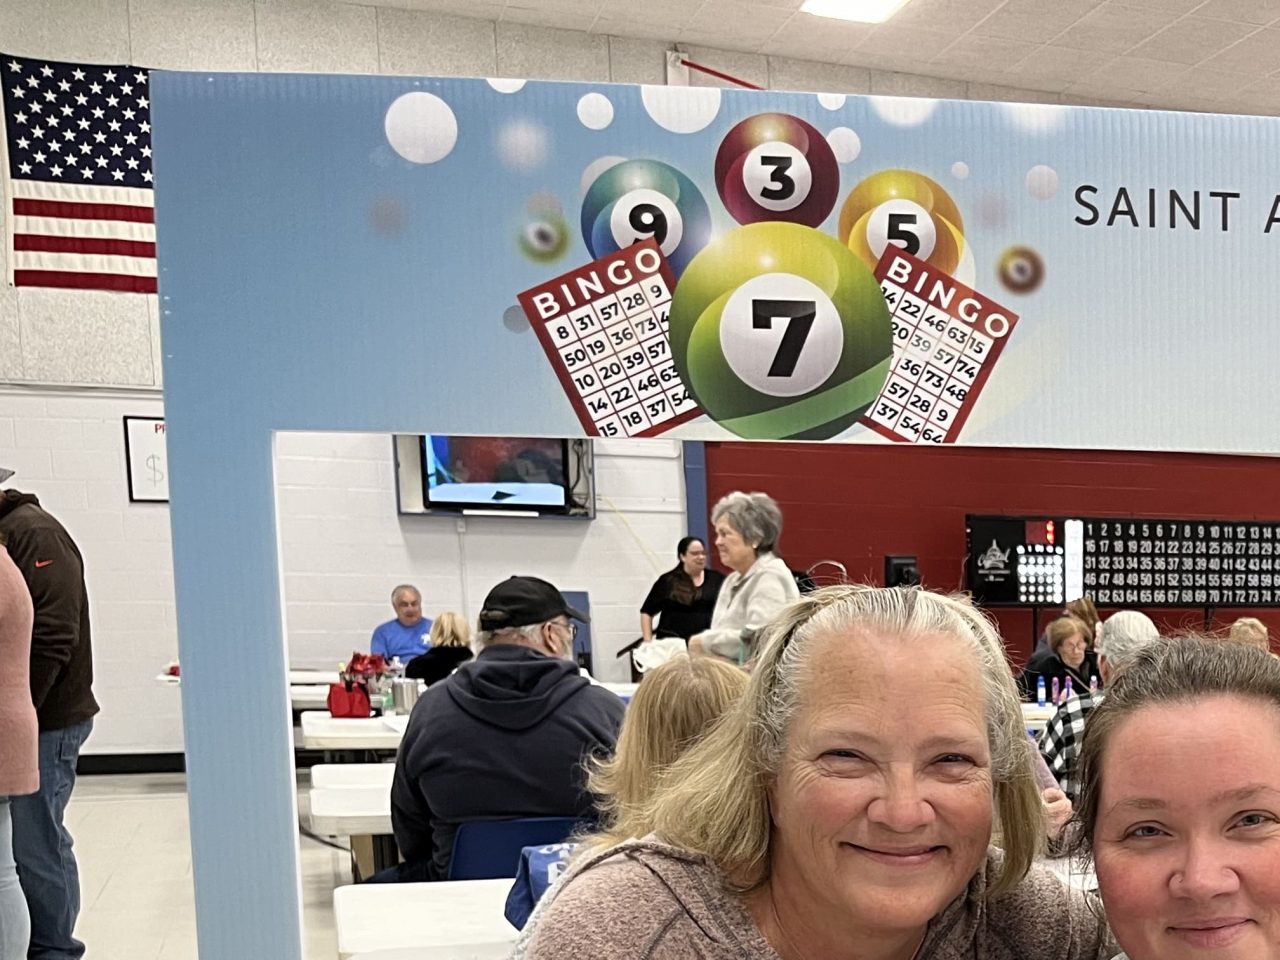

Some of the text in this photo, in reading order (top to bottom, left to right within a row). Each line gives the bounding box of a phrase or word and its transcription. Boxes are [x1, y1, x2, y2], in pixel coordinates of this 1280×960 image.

[759, 156, 795, 201] 3
[629, 203, 667, 245] 9
[1074, 184, 1240, 231] SAINT
[886, 214, 920, 257] 5
[533, 248, 661, 320] BINGO
[887, 256, 1009, 338] BINGO
[557, 285, 662, 339] 8 31 57 28 9
[901, 300, 921, 318] 22
[925, 315, 945, 332] 46
[948, 327, 968, 344] 63
[969, 337, 985, 354] 15
[565, 317, 656, 367] 50 19 36 73
[751, 299, 816, 378] 7
[911, 334, 931, 352] 39
[934, 349, 955, 364] 57
[959, 360, 975, 379] 74
[575, 341, 666, 390] 10 20 39 57
[900, 359, 967, 401] 36 73 48
[588, 398, 608, 414] 14
[611, 387, 633, 404] 22
[638, 374, 659, 392] 46
[888, 382, 948, 422] 57 28 9
[599, 422, 618, 437] 15
[623, 411, 642, 427] 18
[647, 399, 667, 417] 37
[877, 403, 944, 443] 37 54 64
[1088, 524, 1092, 536] 1
[1101, 523, 1108, 536] 2
[1115, 524, 1121, 536] 3
[1129, 524, 1135, 536] 4
[1142, 524, 1149, 537] 5
[1156, 524, 1163, 537] 6
[1170, 524, 1177, 537] 7
[1184, 525, 1191, 537] 8
[1198, 525, 1204, 538] 9
[1210, 526, 1220, 538] 10
[1224, 526, 1232, 538] 11
[1237, 526, 1246, 539] 12
[1250, 527, 1259, 539] 13
[1263, 527, 1272, 539] 14
[1085, 556, 1096, 569] 31
[1098, 556, 1110, 569] 32
[1112, 556, 1124, 569] 33
[1126, 557, 1138, 569] 34
[1140, 557, 1152, 570] 35
[1154, 557, 1166, 570] 36
[1167, 557, 1179, 570] 37
[1182, 558, 1193, 570] 38
[1195, 558, 1206, 570] 39
[1208, 558, 1220, 571] 40
[1222, 558, 1233, 570] 41
[1235, 558, 1246, 571] 42
[1248, 559, 1259, 571] 43
[1261, 559, 1272, 571] 44
